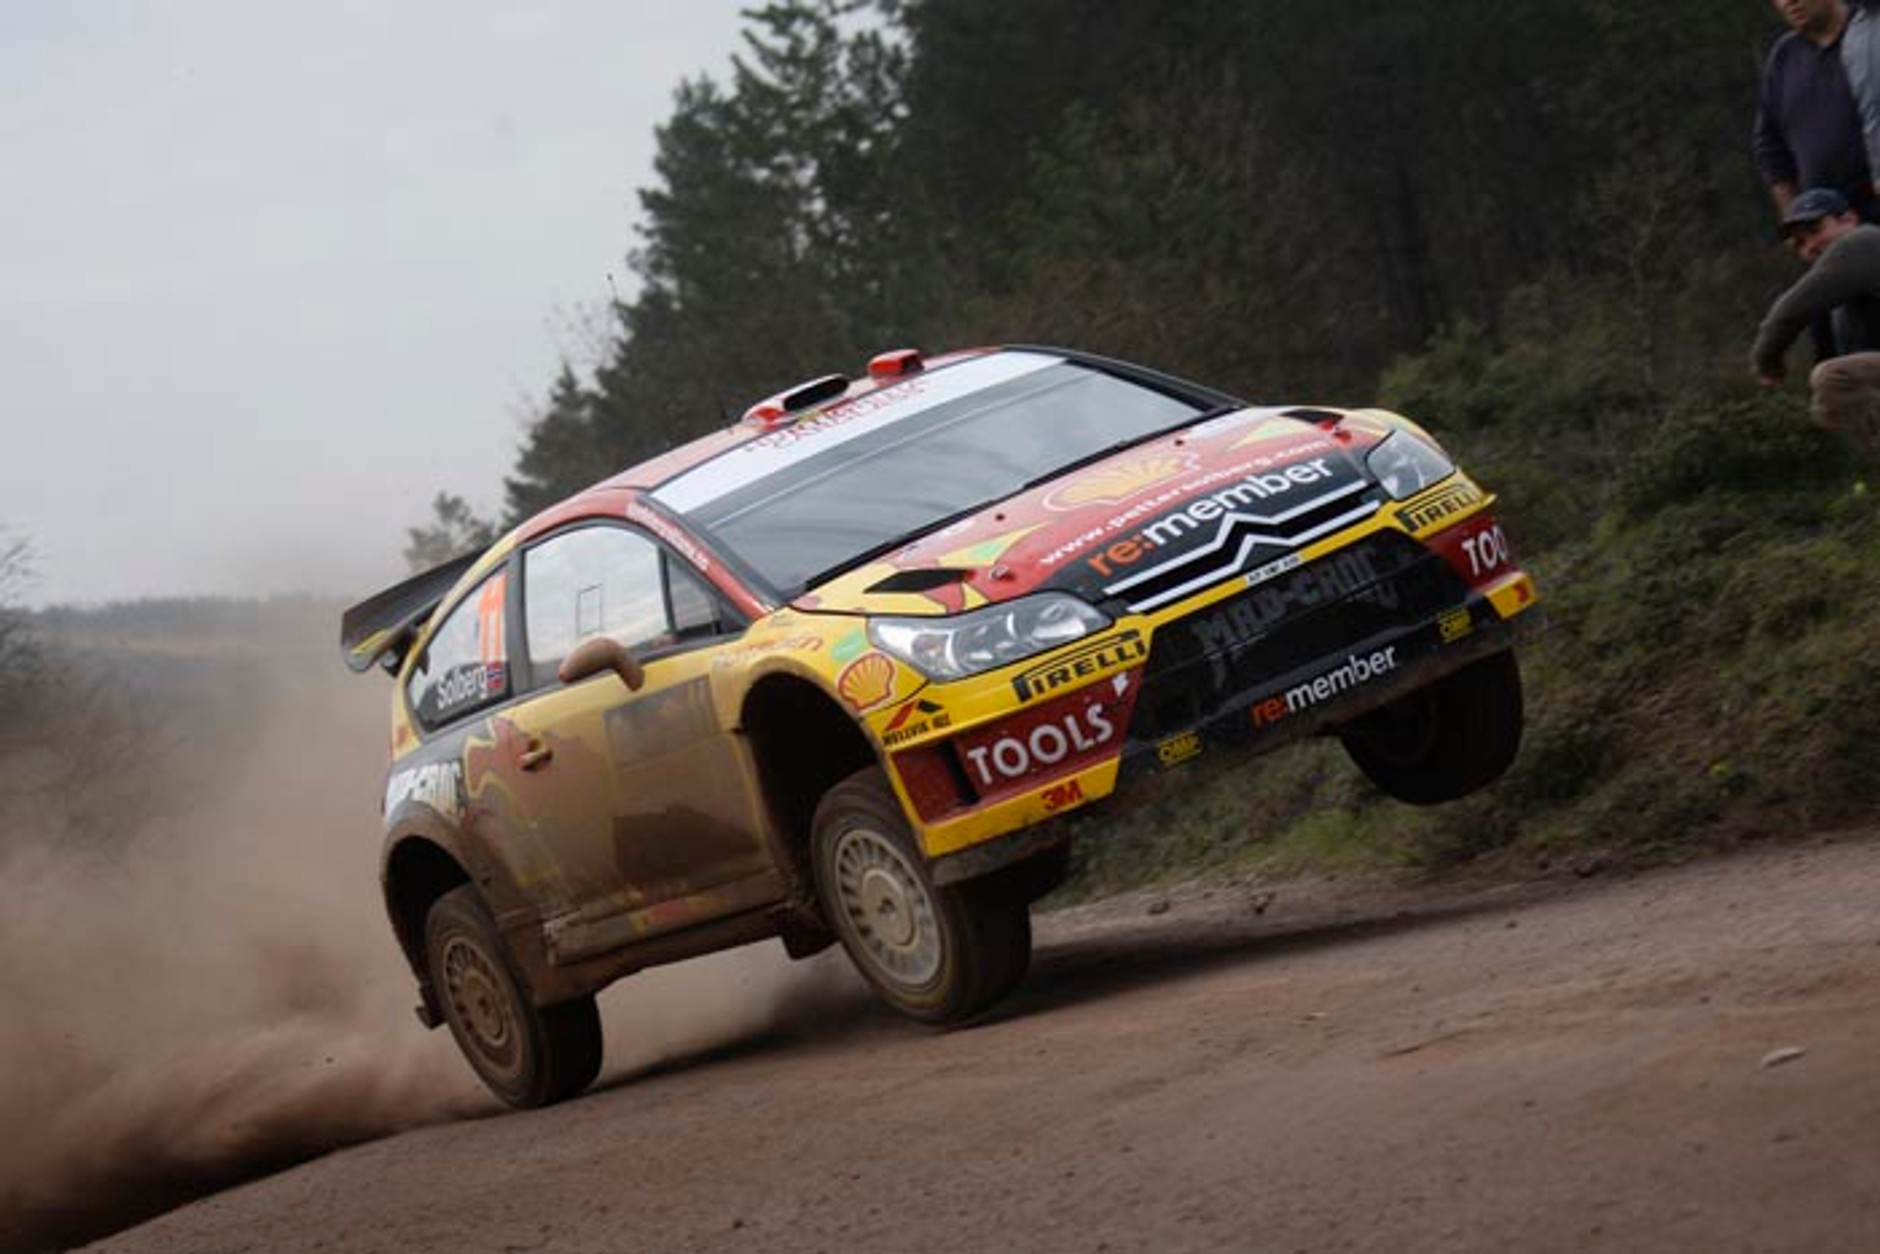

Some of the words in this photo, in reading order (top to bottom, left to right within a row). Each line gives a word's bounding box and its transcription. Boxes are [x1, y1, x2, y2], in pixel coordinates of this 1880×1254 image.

[1087, 457, 1333, 577] re:member
[437, 663, 487, 710] Solberg
[1013, 629, 1146, 702] PIRELLI
[1251, 645, 1396, 728] re:member
[967, 704, 1114, 786] TOOLS
[1041, 780, 1084, 812] 3M
